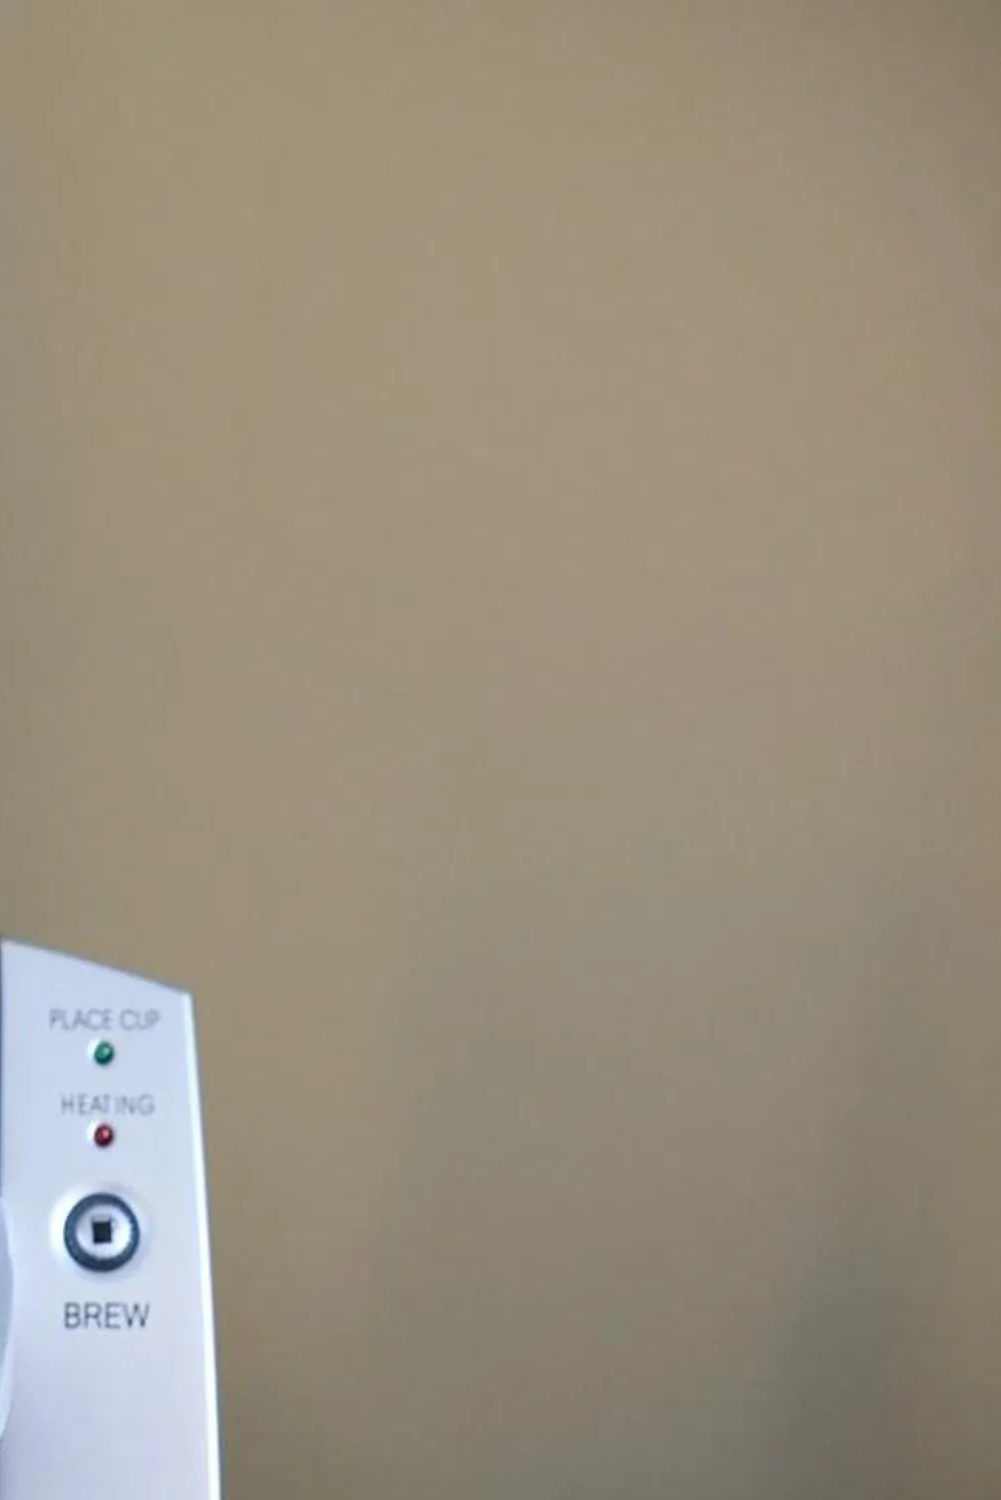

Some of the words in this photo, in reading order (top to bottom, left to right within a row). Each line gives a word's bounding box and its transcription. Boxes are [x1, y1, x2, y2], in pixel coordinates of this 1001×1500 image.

[49, 1008, 113, 1031] PLACE
[119, 1008, 162, 1031] CUP
[60, 1093, 156, 1117] HEATING
[63, 1301, 150, 1330] BREW
